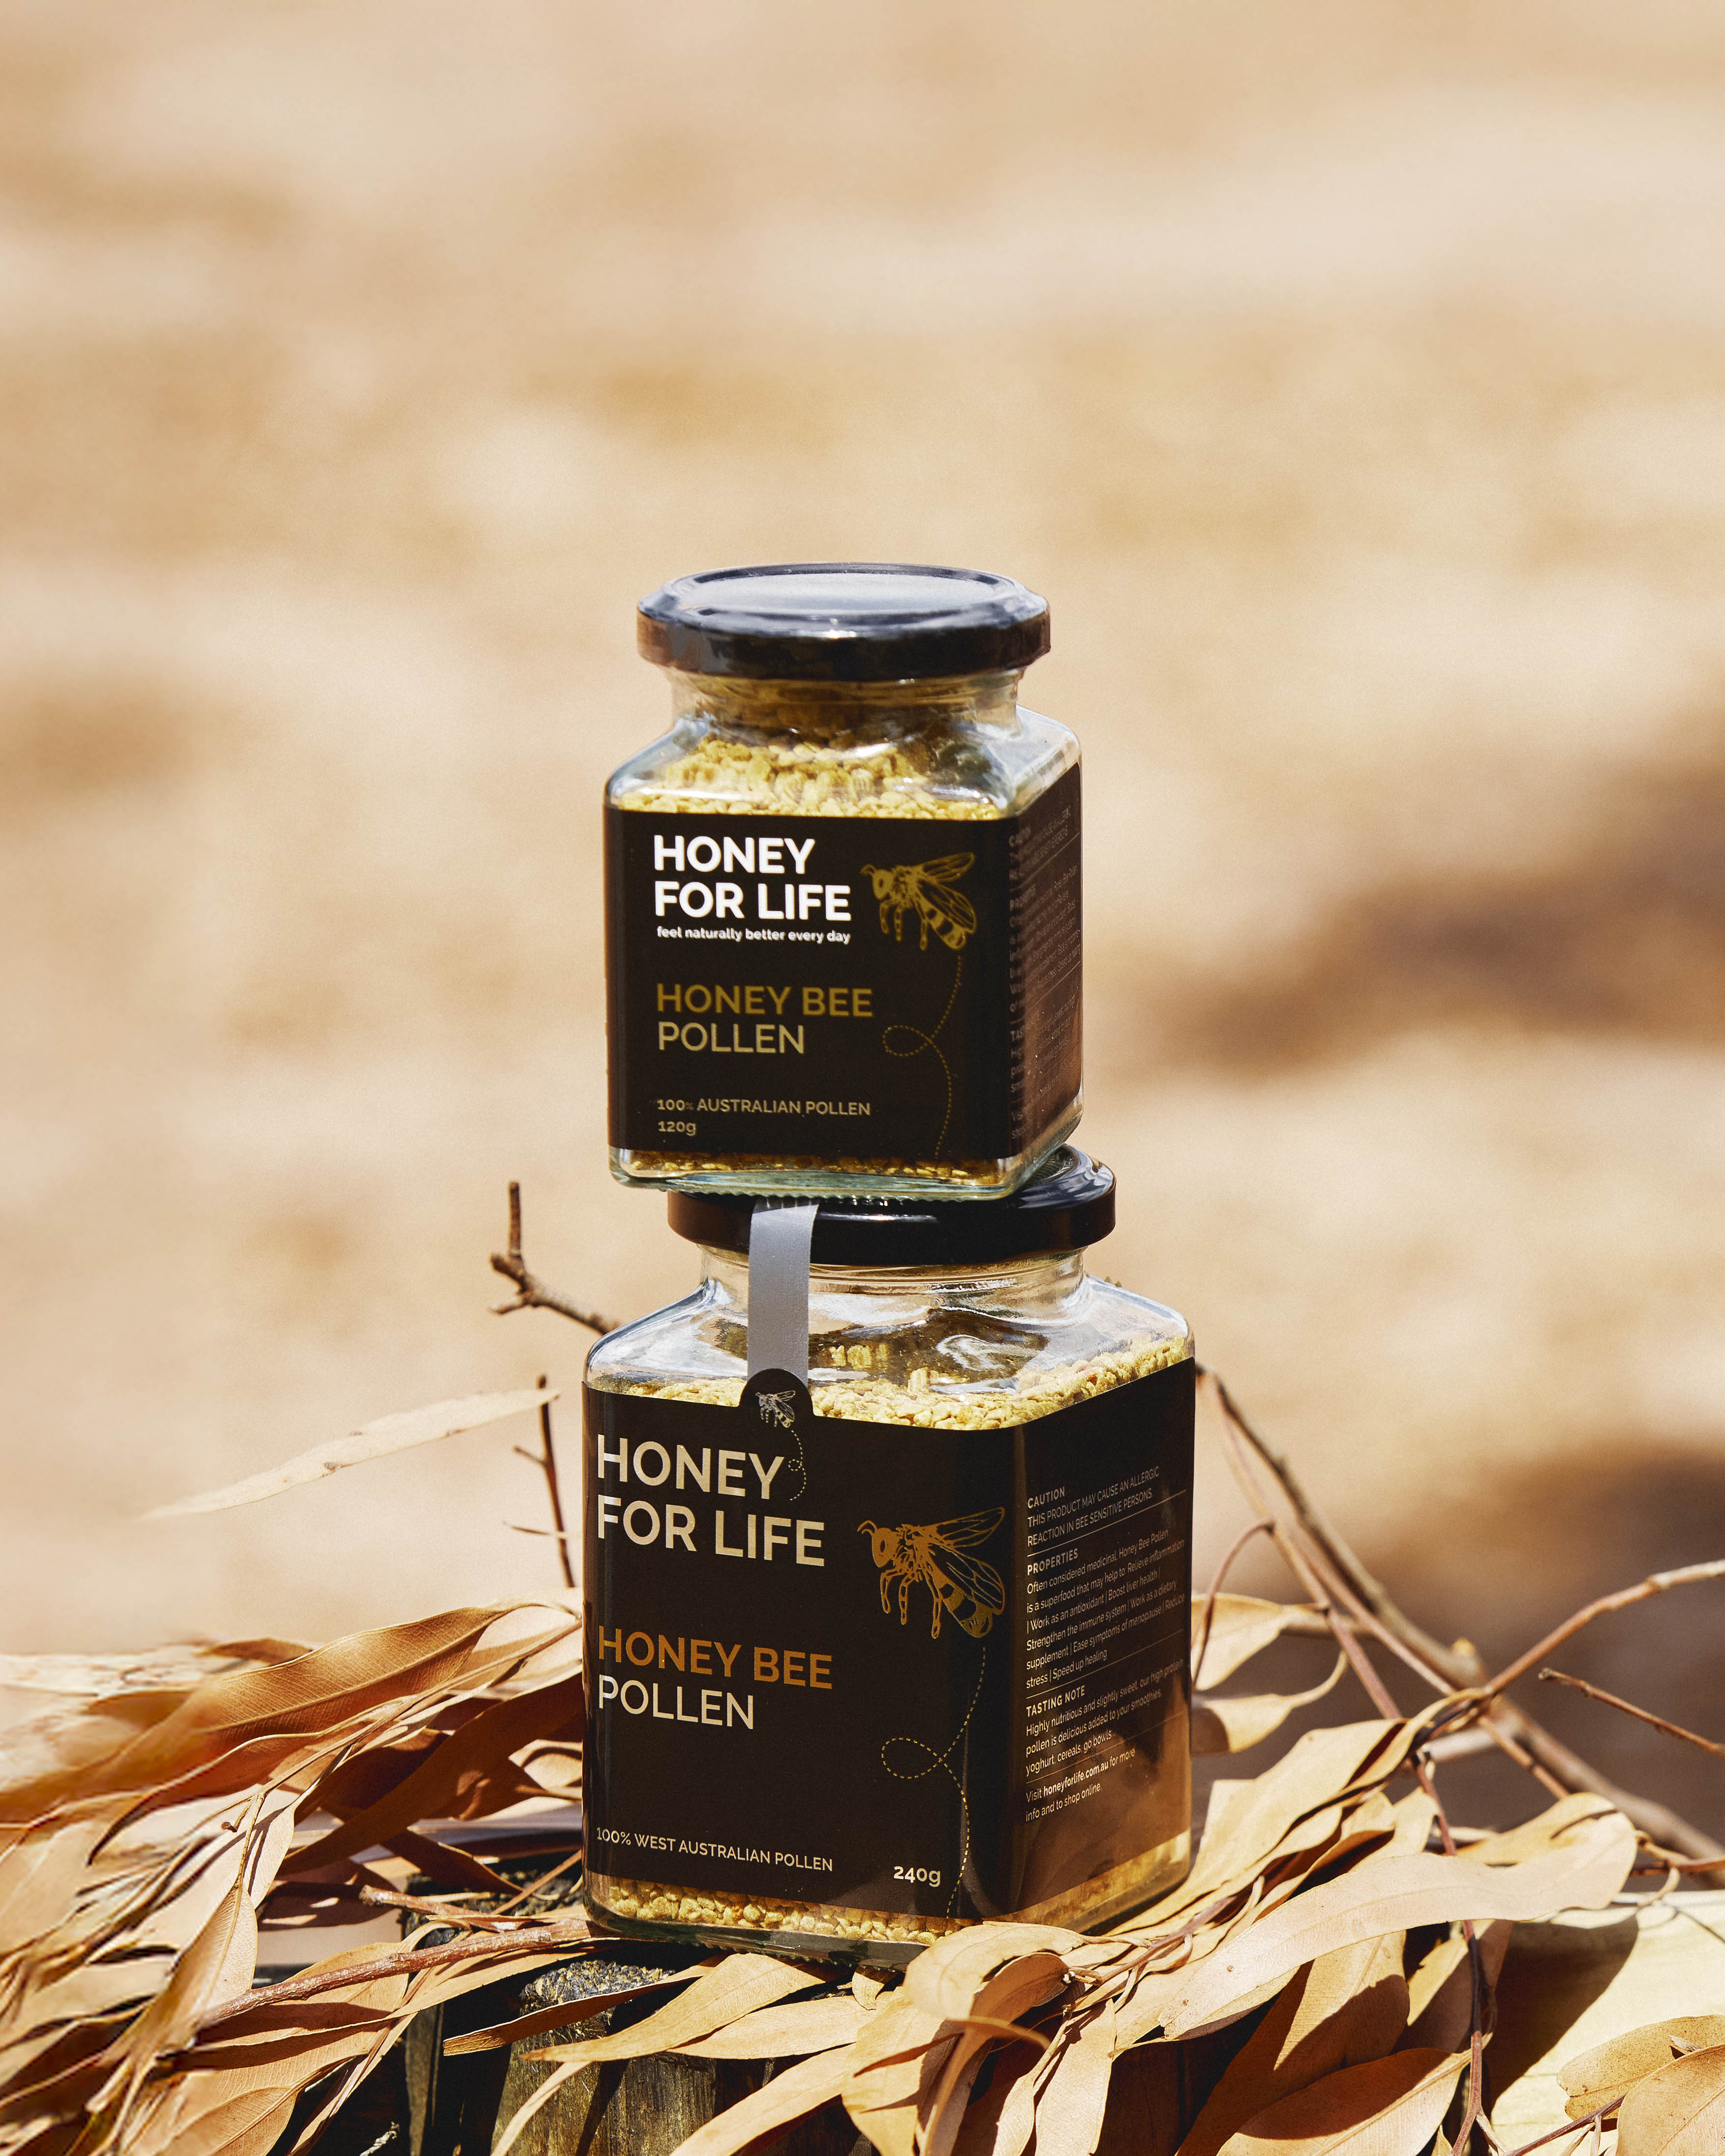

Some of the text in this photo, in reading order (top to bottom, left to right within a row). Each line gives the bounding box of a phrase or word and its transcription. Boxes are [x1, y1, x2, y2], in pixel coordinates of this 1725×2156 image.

[654, 834, 815, 875] HONEY
[655, 880, 852, 921] FOR LIFE
[657, 926, 851, 945] feel naturally better every day
[657, 983, 873, 1017] HONEY BEE
[659, 1021, 804, 1054] POLLEN
[658, 1121, 696, 1136] 120g
[697, 1098, 801, 1114] AUSTRALIAN
[806, 1101, 870, 1115] POLLEN
[597, 1434, 785, 1500] HONEY
[1027, 1466, 1159, 1528] THIS PRODUCT MAY CAUSE AN ALLERGIC
[1027, 1486, 1065, 1509] CAUTION
[598, 1494, 825, 1567] FOR LIFE
[1028, 1524, 1065, 1547] REACTION
[1066, 1521, 1074, 1533] IN
[1075, 1515, 1089, 1529] BEE
[1090, 1501, 1122, 1524] SENSITIVE
[1027, 1580, 1048, 1594] Often
[1049, 1563, 1086, 1587] considered
[1119, 1545, 1138, 1558] Honey
[1139, 1538, 1150, 1550] Bee
[1151, 1529, 1168, 1544] Pollen
[1027, 1548, 1078, 1576] PROPERTIES
[1027, 1603, 1033, 1613] is
[1034, 1602, 1039, 1611] a
[1040, 1586, 1075, 1609] superfood
[1076, 1581, 1090, 1595] that
[1091, 1577, 1104, 1590] may
[1104, 1570, 1118, 1583] help
[1127, 1557, 1149, 1573] Relieve
[1149, 1539, 1184, 1563] inflammation
[1026, 1630, 1066, 1651] Strengthen
[1067, 1625, 1078, 1636] the
[1079, 1614, 1104, 1631] immune
[1105, 1604, 1126, 1622] system
[1130, 1593, 1145, 1608] Work
[1146, 1591, 1153, 1602] as
[1154, 1589, 1158, 1598] a
[1030, 1615, 1050, 1630] Work
[1051, 1614, 1059, 1624] as
[1060, 1610, 1068, 1620] an
[1069, 1593, 1104, 1617] antioxidant
[1108, 1584, 1125, 1601] Boost
[1126, 1580, 1139, 1593] liver
[1140, 1569, 1158, 1586] health
[599, 1625, 832, 1689] HONEY BEE
[1026, 1645, 1069, 1670] supplement
[1073, 1639, 1089, 1653] Ease
[1089, 1625, 1120, 1648] symptoms
[1121, 1618, 1128, 1631] of
[1128, 1605, 1162, 1628] menopause
[1026, 1674, 1048, 1689] stress
[1053, 1660, 1074, 1680] Speed
[1075, 1659, 1084, 1671] up
[1085, 1649, 1107, 1666] healing
[599, 1674, 754, 1730] POLLEN
[1026, 1685, 1085, 1717] TASTING NOTE
[1026, 1720, 1050, 1736] Highly
[1051, 1707, 1083, 1727] nutritious
[1083, 1699, 1095, 1714] and
[1096, 1690, 1119, 1708] slightly
[1140, 1676, 1150, 1688] our
[1150, 1669, 1164, 1683] high
[1026, 1739, 1050, 1758] pollen
[1051, 1735, 1057, 1746] is
[1058, 1723, 1087, 1743] delicious
[1088, 1711, 1108, 1730] added
[1110, 1710, 1116, 1721] to
[1116, 1704, 1130, 1720] your
[1083, 1740, 1092, 1754] go
[1026, 1748, 1136, 1803] Visit honeyforlife.com.au for more
[1026, 1783, 1102, 1822] info and to shop online.
[597, 1827, 833, 1872] 100% WEST AUSTRALIAN POLLEN
[893, 1866, 940, 1887] 240g
